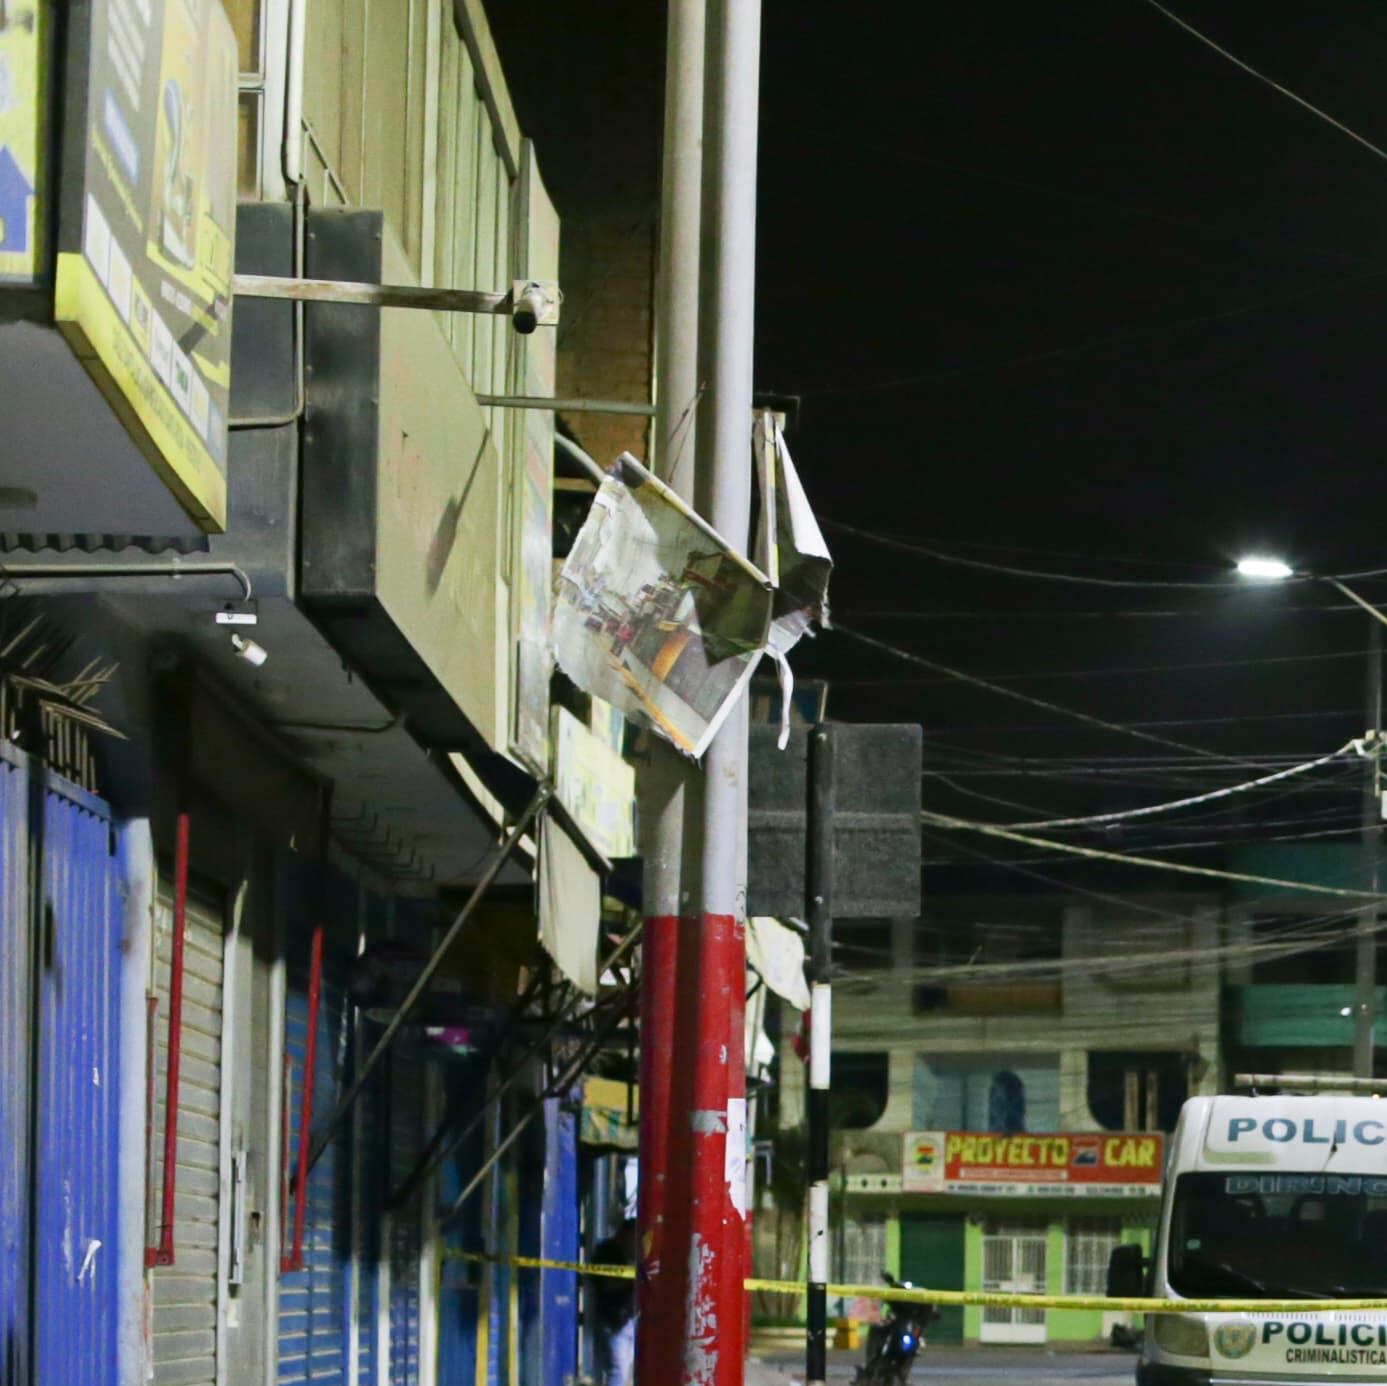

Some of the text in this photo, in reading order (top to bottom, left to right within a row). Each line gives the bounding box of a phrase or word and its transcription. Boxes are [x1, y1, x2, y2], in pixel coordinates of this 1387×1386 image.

[945, 1134, 1157, 1167] PROYECTO CAR
[1285, 1348, 1387, 1365] CRIMINALISTICA
